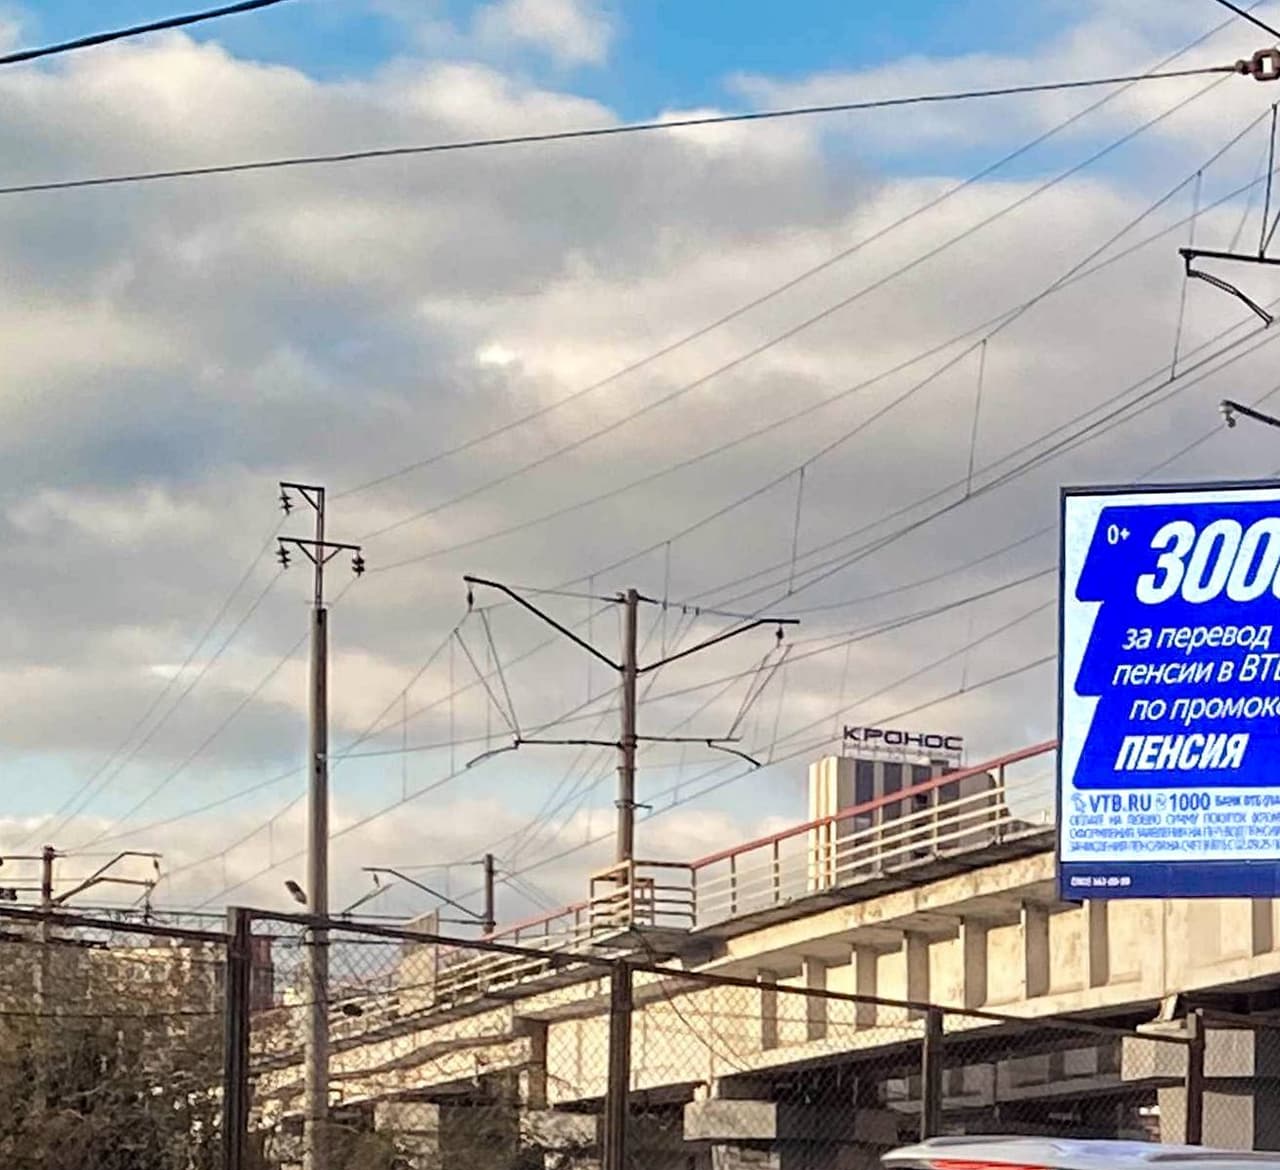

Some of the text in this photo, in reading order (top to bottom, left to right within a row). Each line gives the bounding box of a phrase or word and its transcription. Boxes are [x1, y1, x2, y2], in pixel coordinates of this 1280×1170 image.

[1107, 523, 1130, 545] 0+
[1121, 624, 1273, 655] за перевод
[1112, 661, 1215, 686] пенсии
[1217, 660, 1235, 683] в
[1128, 698, 1167, 721] по
[843, 725, 963, 751] КРОНОС
[1114, 732, 1250, 771] ПЕНСИЯ
[1088, 792, 1211, 813] VTB.RU 1000
